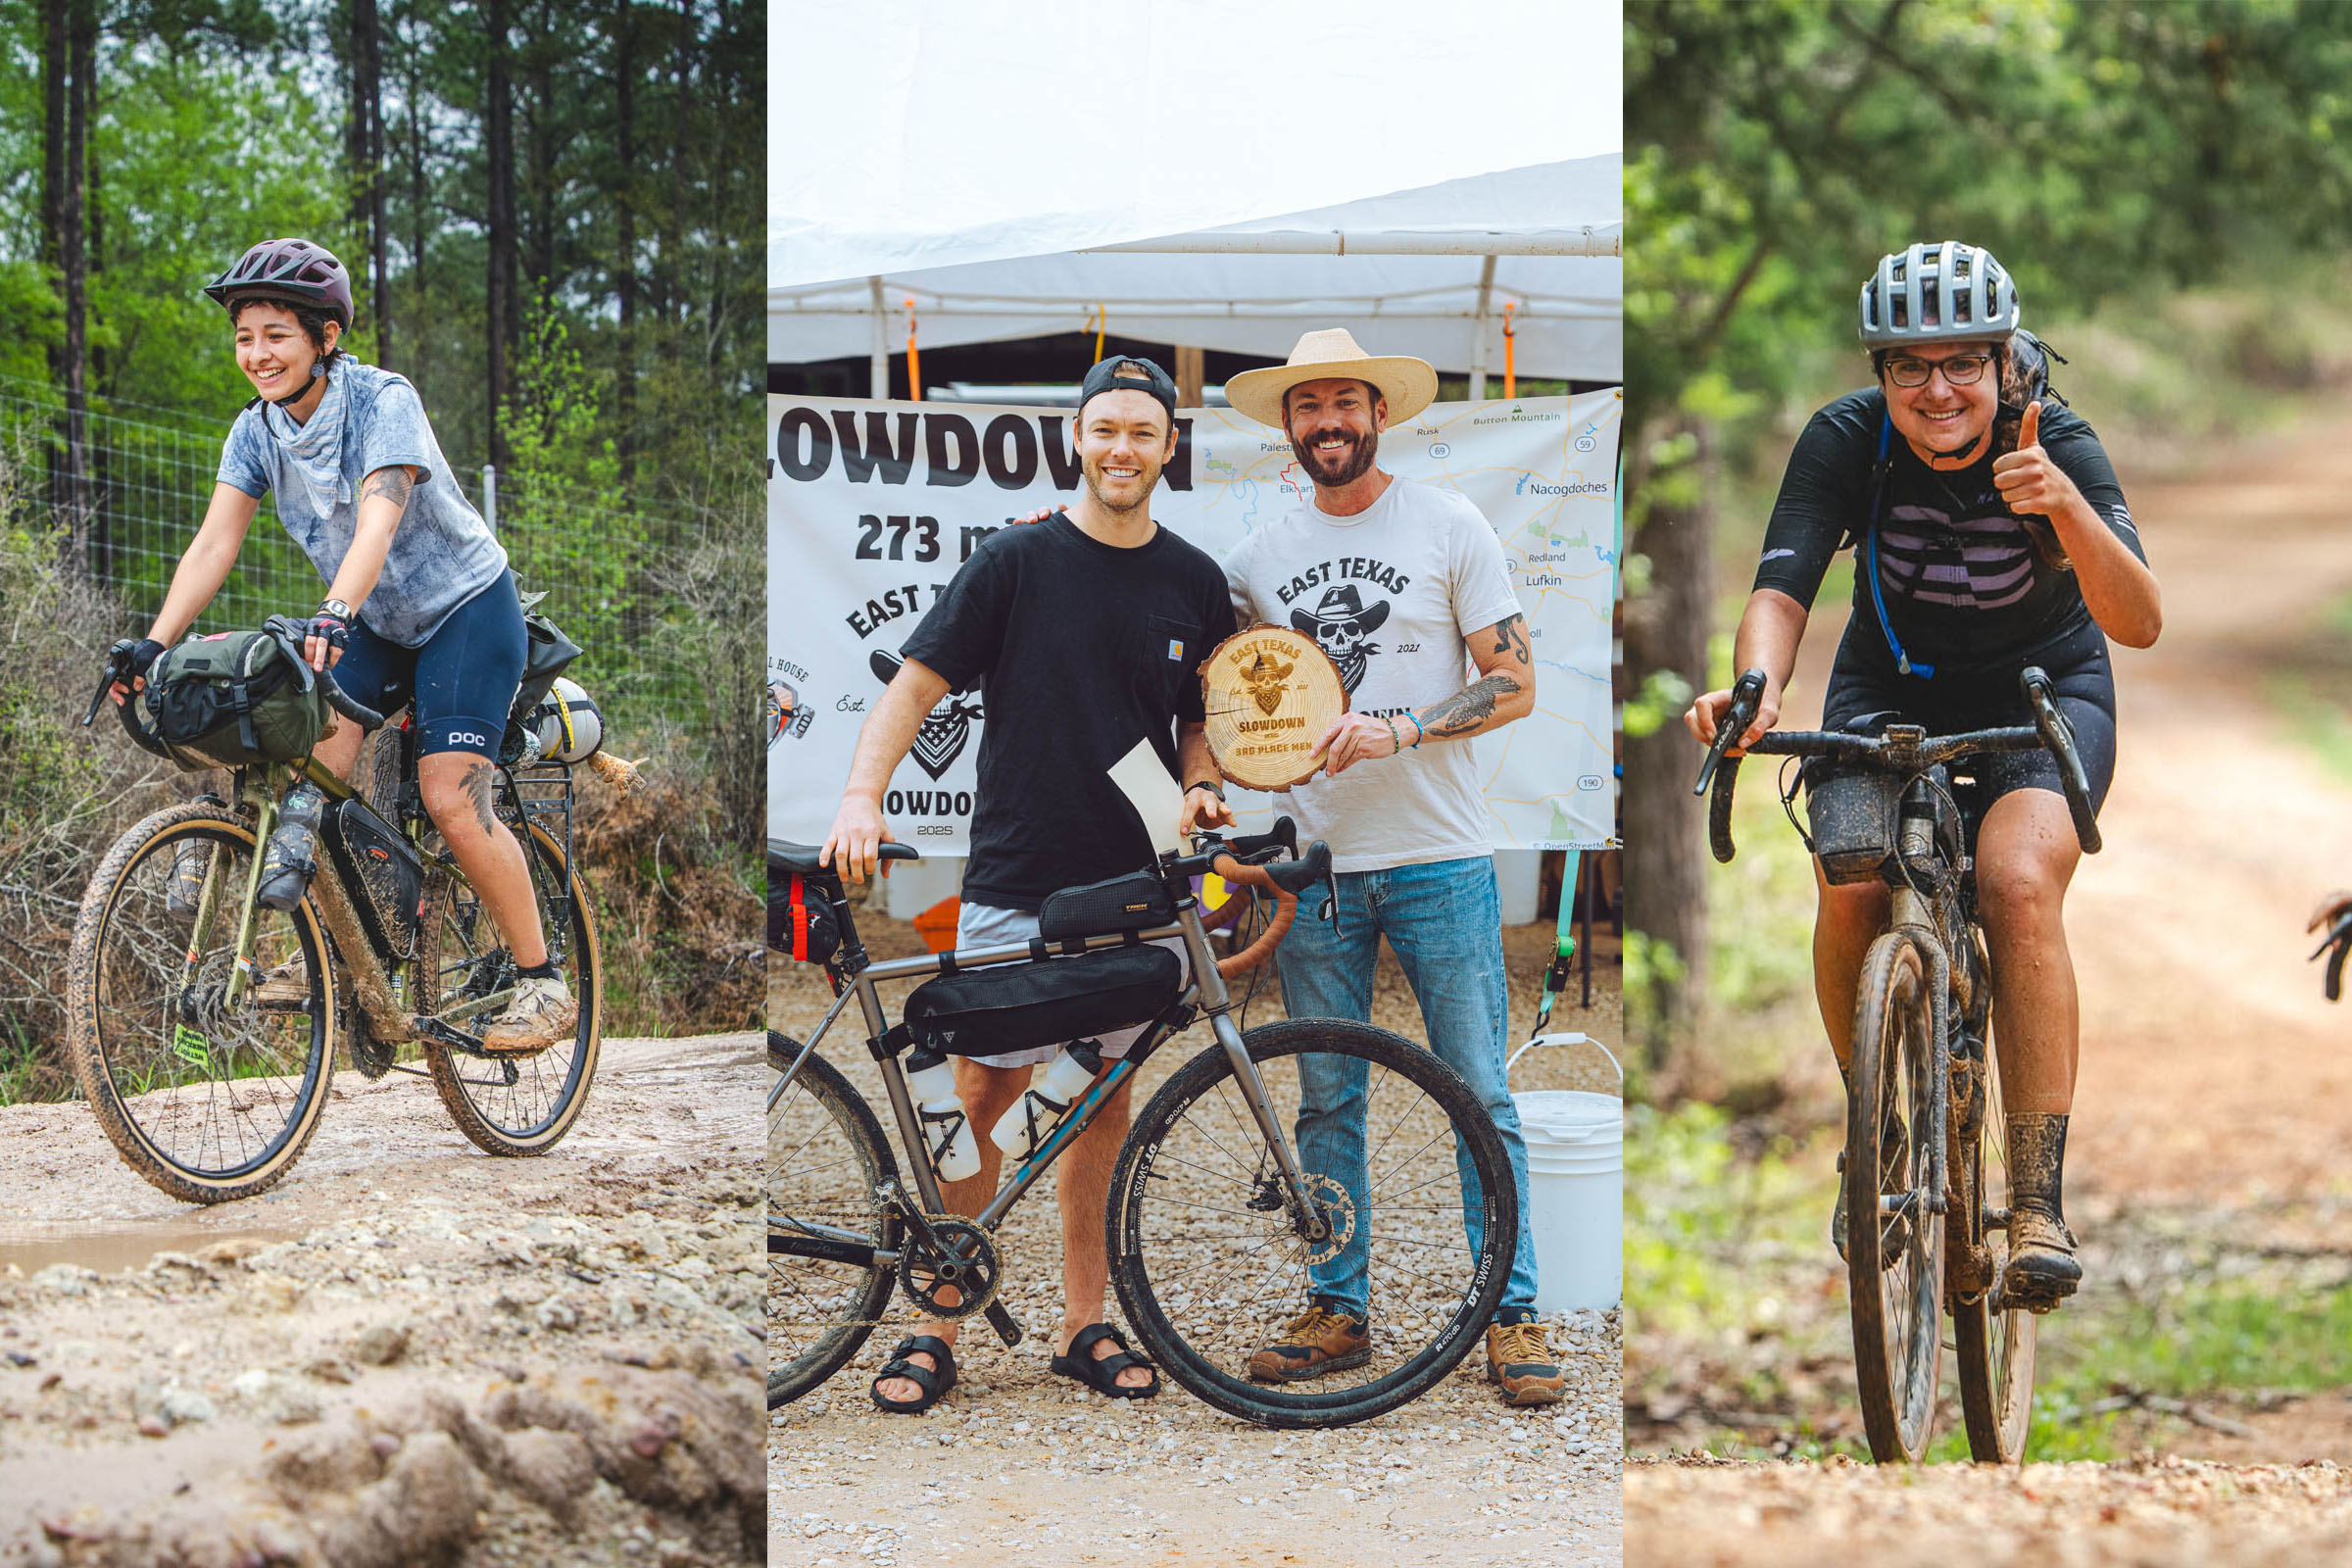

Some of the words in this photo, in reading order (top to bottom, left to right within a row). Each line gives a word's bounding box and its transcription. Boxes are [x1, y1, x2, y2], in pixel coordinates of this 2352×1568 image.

[1510, 413, 1561, 422] Mountain
[1417, 427, 1440, 437] Rusk
[767, 408, 1194, 491] OWDOW
[1435, 447, 1446, 456] 69
[1580, 440, 1592, 449] 59
[1531, 482, 1608, 498] Nacogdoches
[856, 514, 941, 563] 273
[1529, 553, 1566, 564] Redland
[1276, 562, 1332, 606] EAST
[1339, 558, 1410, 595] TEXAS
[1526, 574, 1562, 587] Lufkin
[845, 584, 919, 640] EAST
[1229, 640, 1258, 665] EAST
[1261, 639, 1302, 660] TEXAS
[1396, 644, 1421, 654] 2021
[776, 659, 809, 683] HOUSE
[836, 694, 865, 712] Est.
[1239, 716, 1305, 733] SLOWDOWN
[1236, 747, 1254, 757] 3RD
[1258, 744, 1289, 755] PLACE
[1292, 742, 1312, 752] MEN
[881, 790, 977, 816] OWDO
[917, 826, 954, 836] 2025
[1145, 1142, 1158, 1163] DT
[1134, 1163, 1150, 1198] SWISS
[1466, 1287, 1481, 1308] DT
[1477, 1253, 1494, 1288] SWISS
